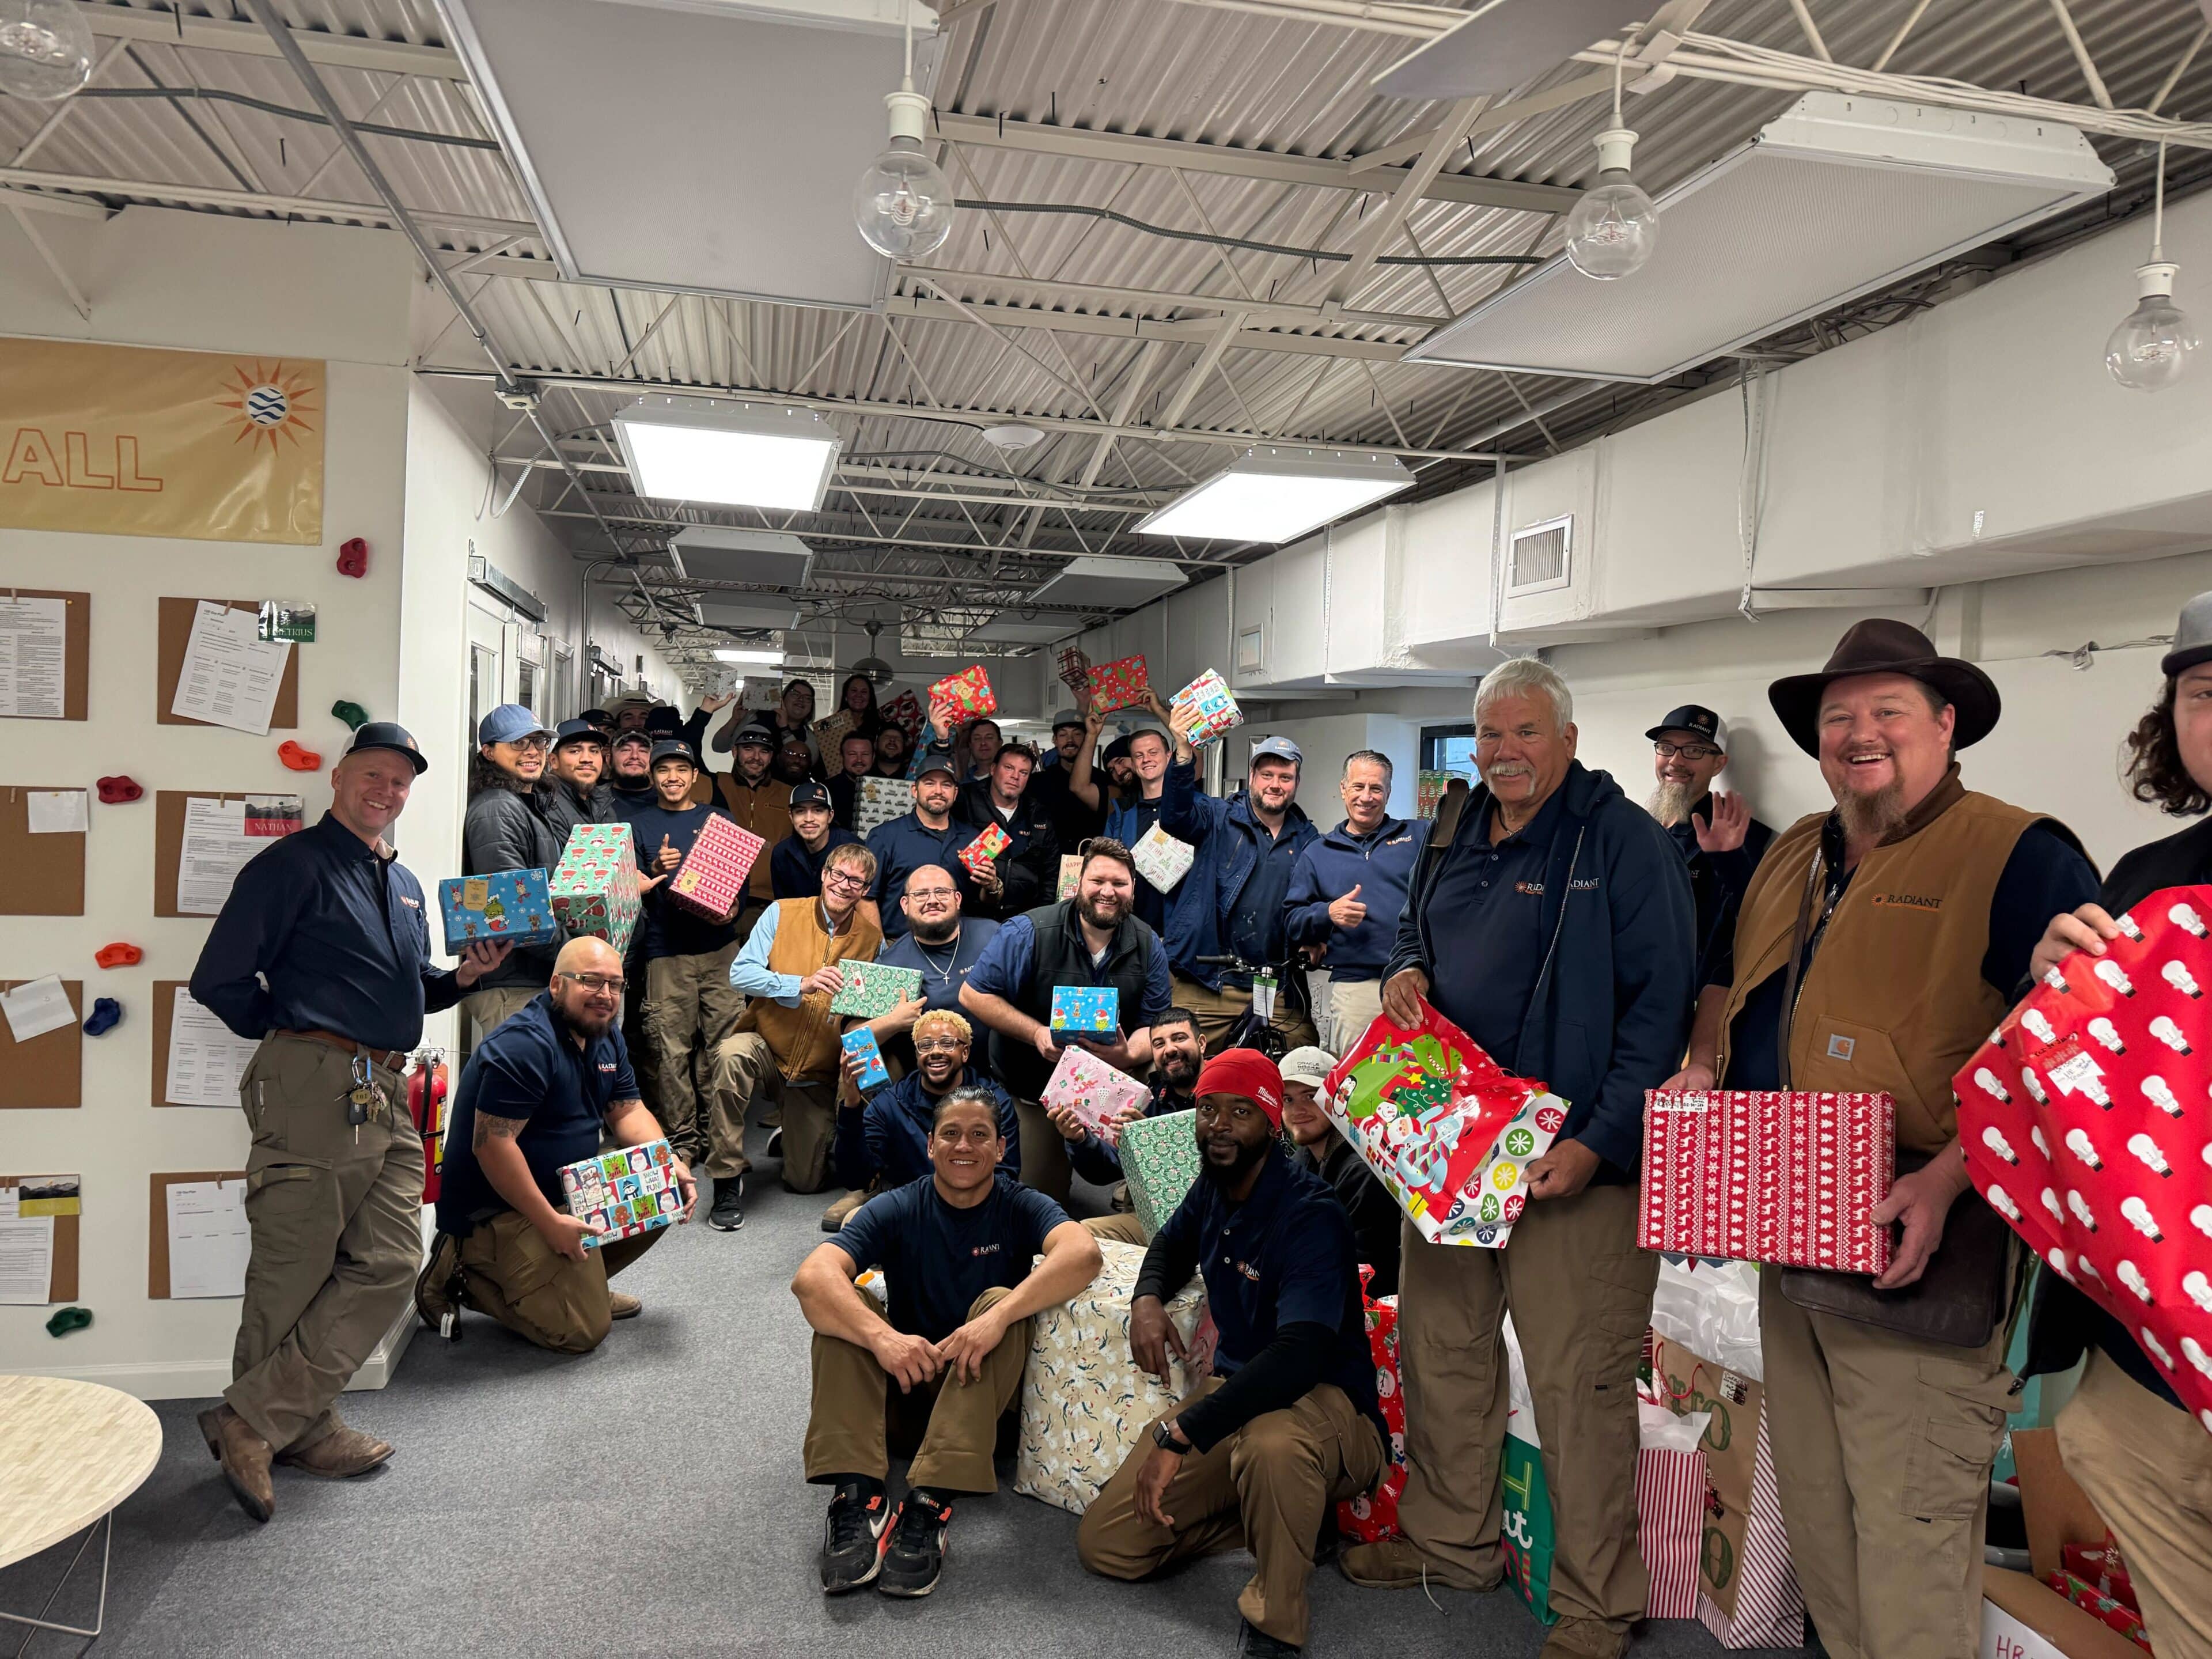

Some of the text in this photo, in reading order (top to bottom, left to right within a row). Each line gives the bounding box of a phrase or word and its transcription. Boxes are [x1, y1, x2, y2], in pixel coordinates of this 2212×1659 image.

[2, 427, 164, 493] ALL
[1688, 722, 1712, 734] RADIANT
[255, 823, 292, 831] NATHAN
[1888, 895, 1943, 908] RADIANT
[643, 1169, 658, 1178] SNOW
[645, 1176, 660, 1184] WHAT
[646, 1182, 662, 1192] FUN!
